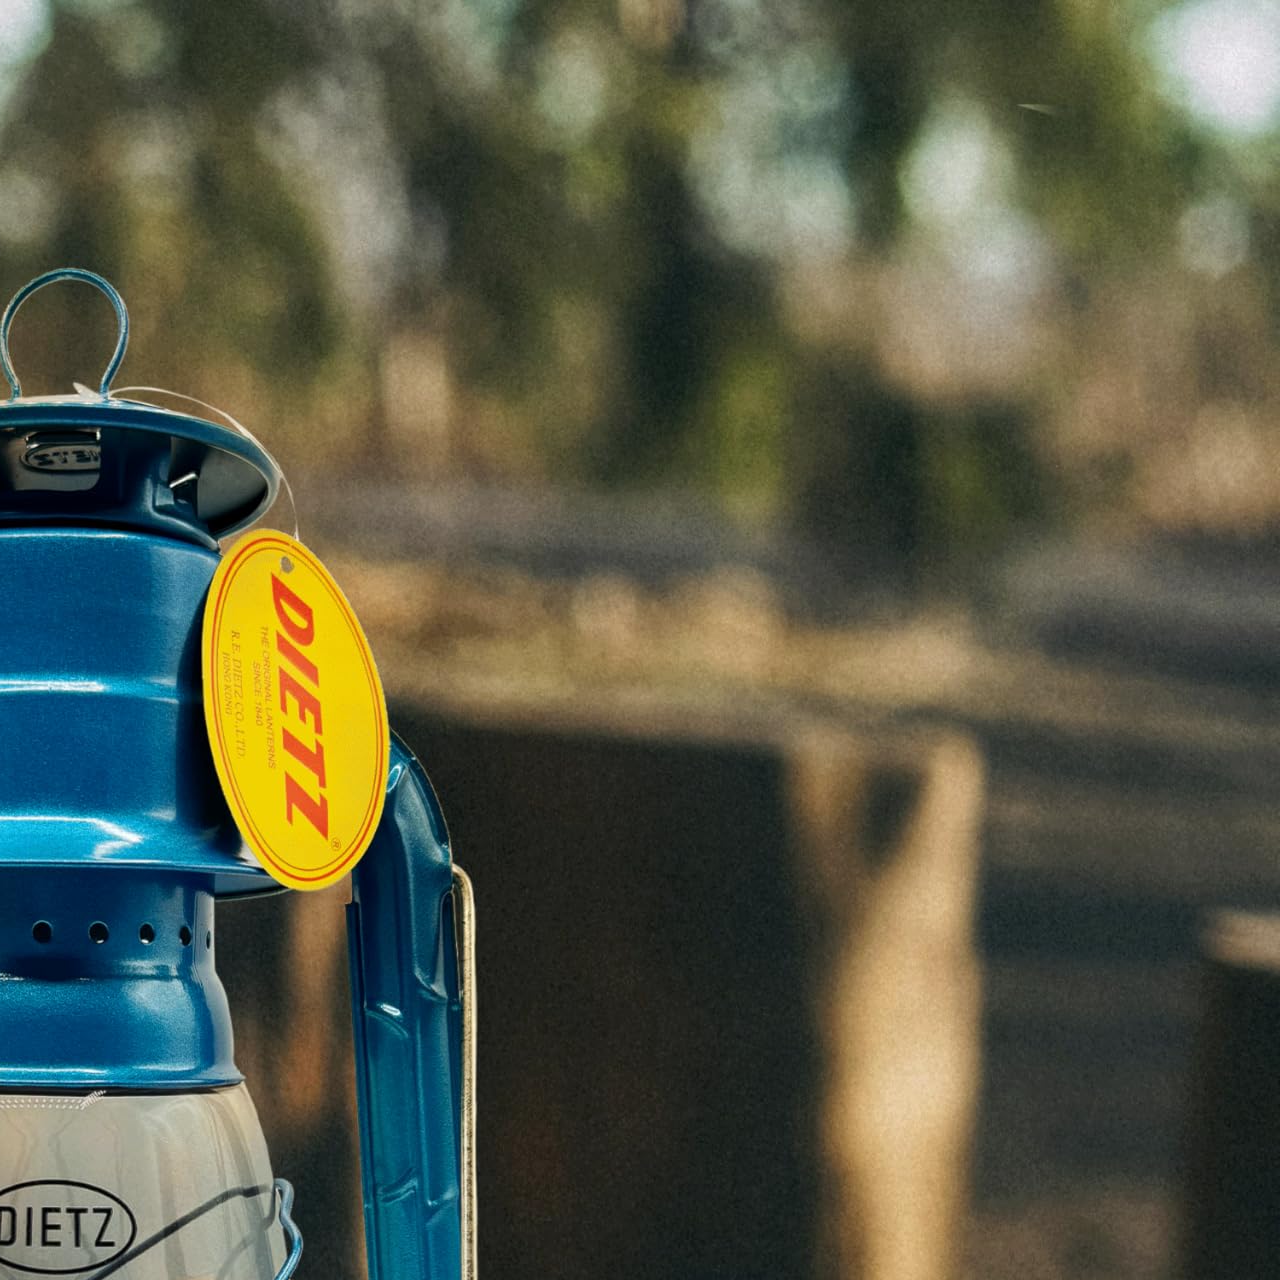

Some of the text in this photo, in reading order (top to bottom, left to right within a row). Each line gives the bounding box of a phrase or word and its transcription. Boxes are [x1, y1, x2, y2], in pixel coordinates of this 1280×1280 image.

[222, 651, 232, 716] HONG KONG
[232, 657, 243, 698] DIETZ
[252, 662, 263, 727] SINCE 1840
[260, 626, 276, 769] THE ORIGINAL LANTERNS
[271, 573, 329, 841] DIETZ
